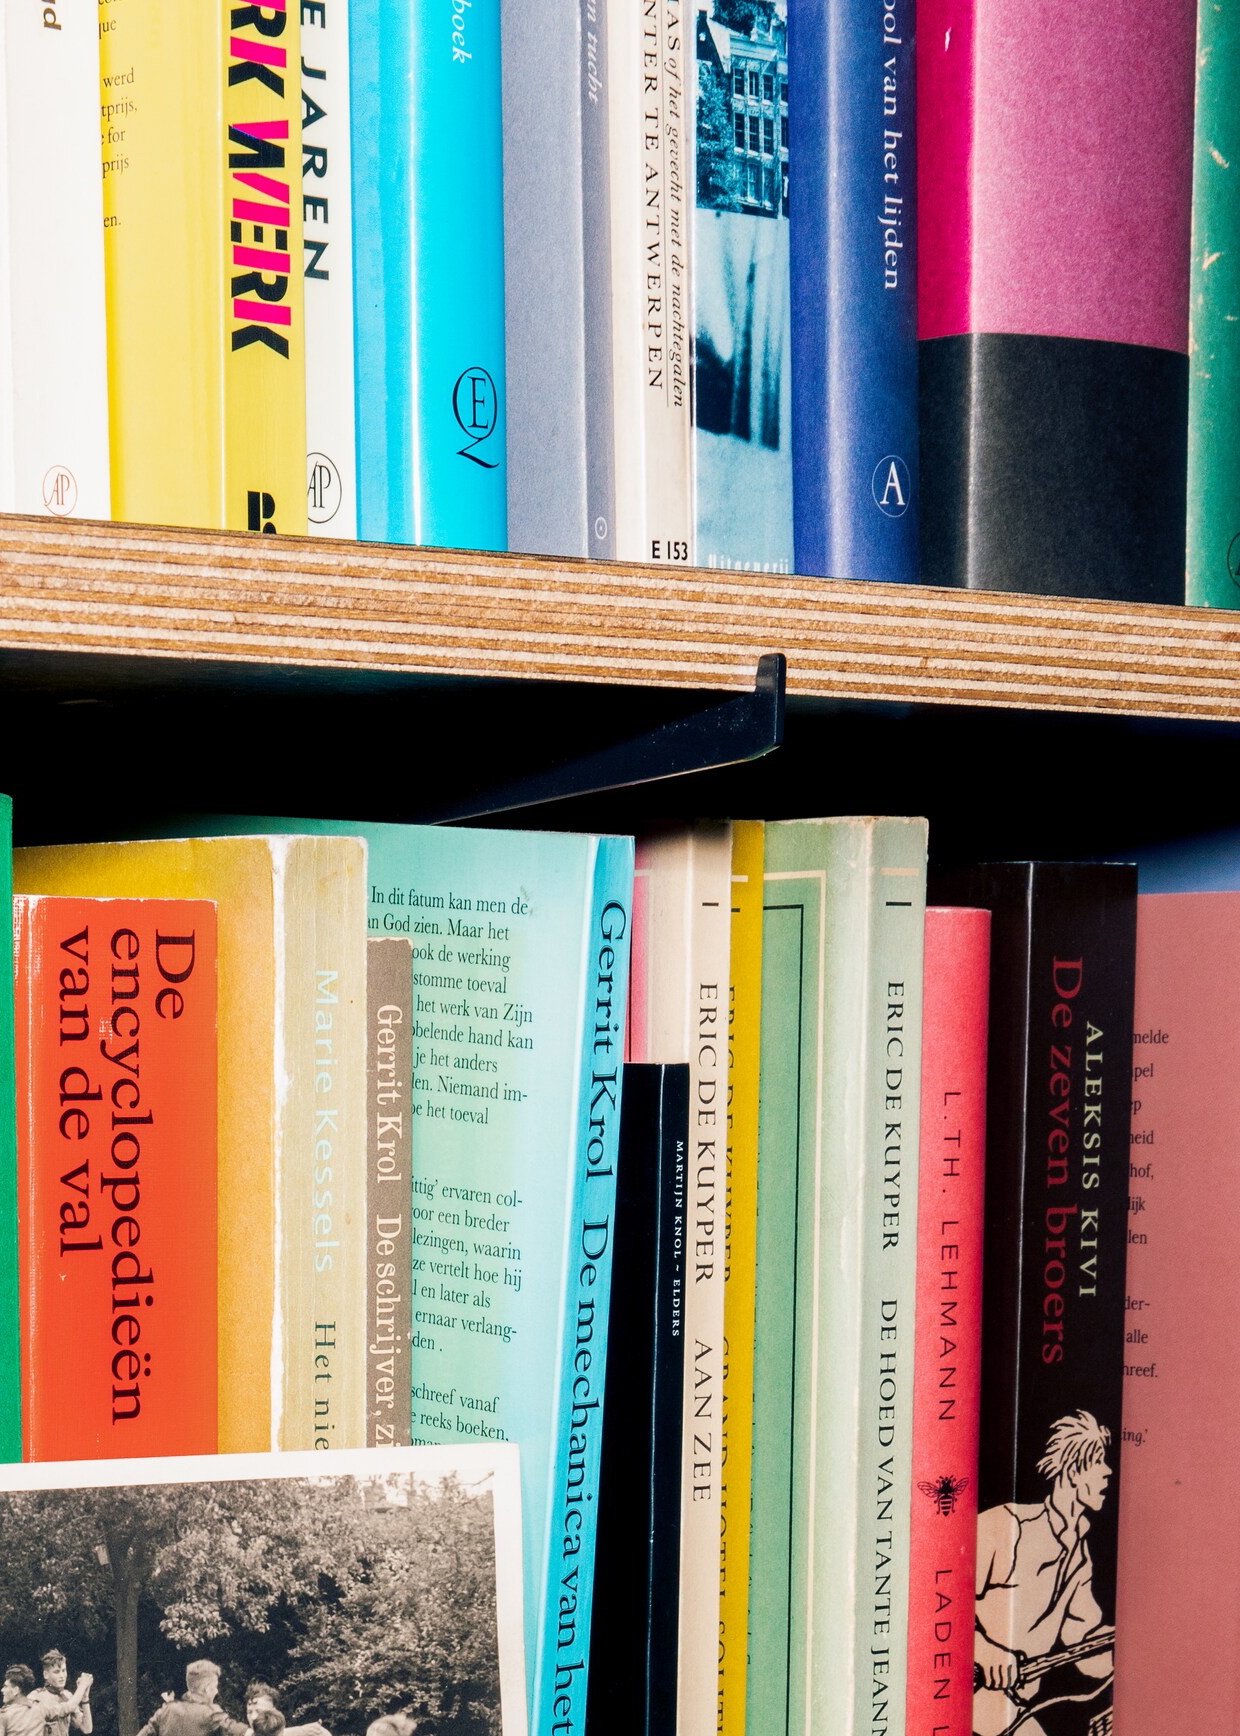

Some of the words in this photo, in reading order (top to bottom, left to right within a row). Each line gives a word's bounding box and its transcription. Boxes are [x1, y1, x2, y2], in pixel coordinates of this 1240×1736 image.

[103, 67, 135, 88] werd
[663, 56, 682, 84] of
[668, 87, 682, 119] het
[882, 56, 898, 117] van
[644, 110, 659, 151] TE
[666, 122, 682, 202] gevecht
[883, 128, 903, 185] het
[669, 208, 682, 247] met
[670, 252, 685, 278] de
[876, 193, 904, 290] lijden
[644, 162, 663, 390] ANTWERPEN
[669, 285, 687, 408] nachtegalen
[651, 540, 661, 560] E
[667, 540, 688, 561] 153
[371, 885, 385, 904] In
[388, 888, 405, 906] dit
[408, 889, 444, 909] fatum
[448, 892, 472, 911] kan
[476, 900, 506, 914] men
[511, 896, 529, 916] de
[383, 913, 410, 933] God
[414, 915, 443, 935] zien.
[447, 918, 484, 939] Maar
[488, 922, 510, 941] het
[59, 925, 90, 1049] van
[154, 928, 196, 1020] De
[413, 973, 463, 990] stomme
[467, 976, 507, 995] toeval
[438, 944, 454, 963] de
[457, 947, 512, 972] werking
[594, 899, 626, 1057] Gerrit
[1050, 956, 1084, 1030] De
[313, 969, 339, 1094] Marie
[416, 994, 436, 1013] het
[440, 999, 470, 1018] werk
[474, 1006, 498, 1021] van
[503, 1002, 533, 1028] Zijn
[697, 983, 718, 1072] ERIC
[886, 981, 905, 1058] ERIC
[376, 1004, 403, 1106] Gerrit
[885, 1066, 903, 1112] DE
[59, 1065, 103, 1142] de
[585, 1065, 619, 1184] Krol
[697, 1079, 717, 1129] DE
[1046, 1046, 1072, 1191] zeven
[1082, 1021, 1105, 1191] ALEKSIS
[100, 927, 155, 1427] encyclopedieën
[376, 1111, 403, 1184] Krol
[674, 1140, 684, 1210] MARTIJN
[59, 1158, 103, 1258] val
[312, 1108, 339, 1275] Kessels
[695, 1138, 716, 1286] KUYPER
[881, 1121, 903, 1252] KUYPER
[375, 1213, 402, 1256] De
[579, 1216, 609, 1288] De
[673, 1215, 683, 1258] KNOL
[1078, 1210, 1099, 1299] KIVI
[671, 1279, 681, 1338] ELDERS
[880, 1299, 898, 1343] DE
[937, 1219, 960, 1422] LEHMANN
[1041, 1202, 1079, 1367] broers
[314, 1320, 337, 1386] Het
[369, 1262, 402, 1417] schrijver,
[692, 1337, 714, 1420] AAN
[877, 1350, 898, 1449] HOED
[562, 1298, 601, 1558] mechanica
[692, 1430, 713, 1503] ZEE
[875, 1456, 895, 1523] VAN
[557, 1569, 585, 1650] van
[872, 1529, 892, 1638] TANTE
[932, 1568, 953, 1701] LADEN
[552, 1659, 586, 1736] het
